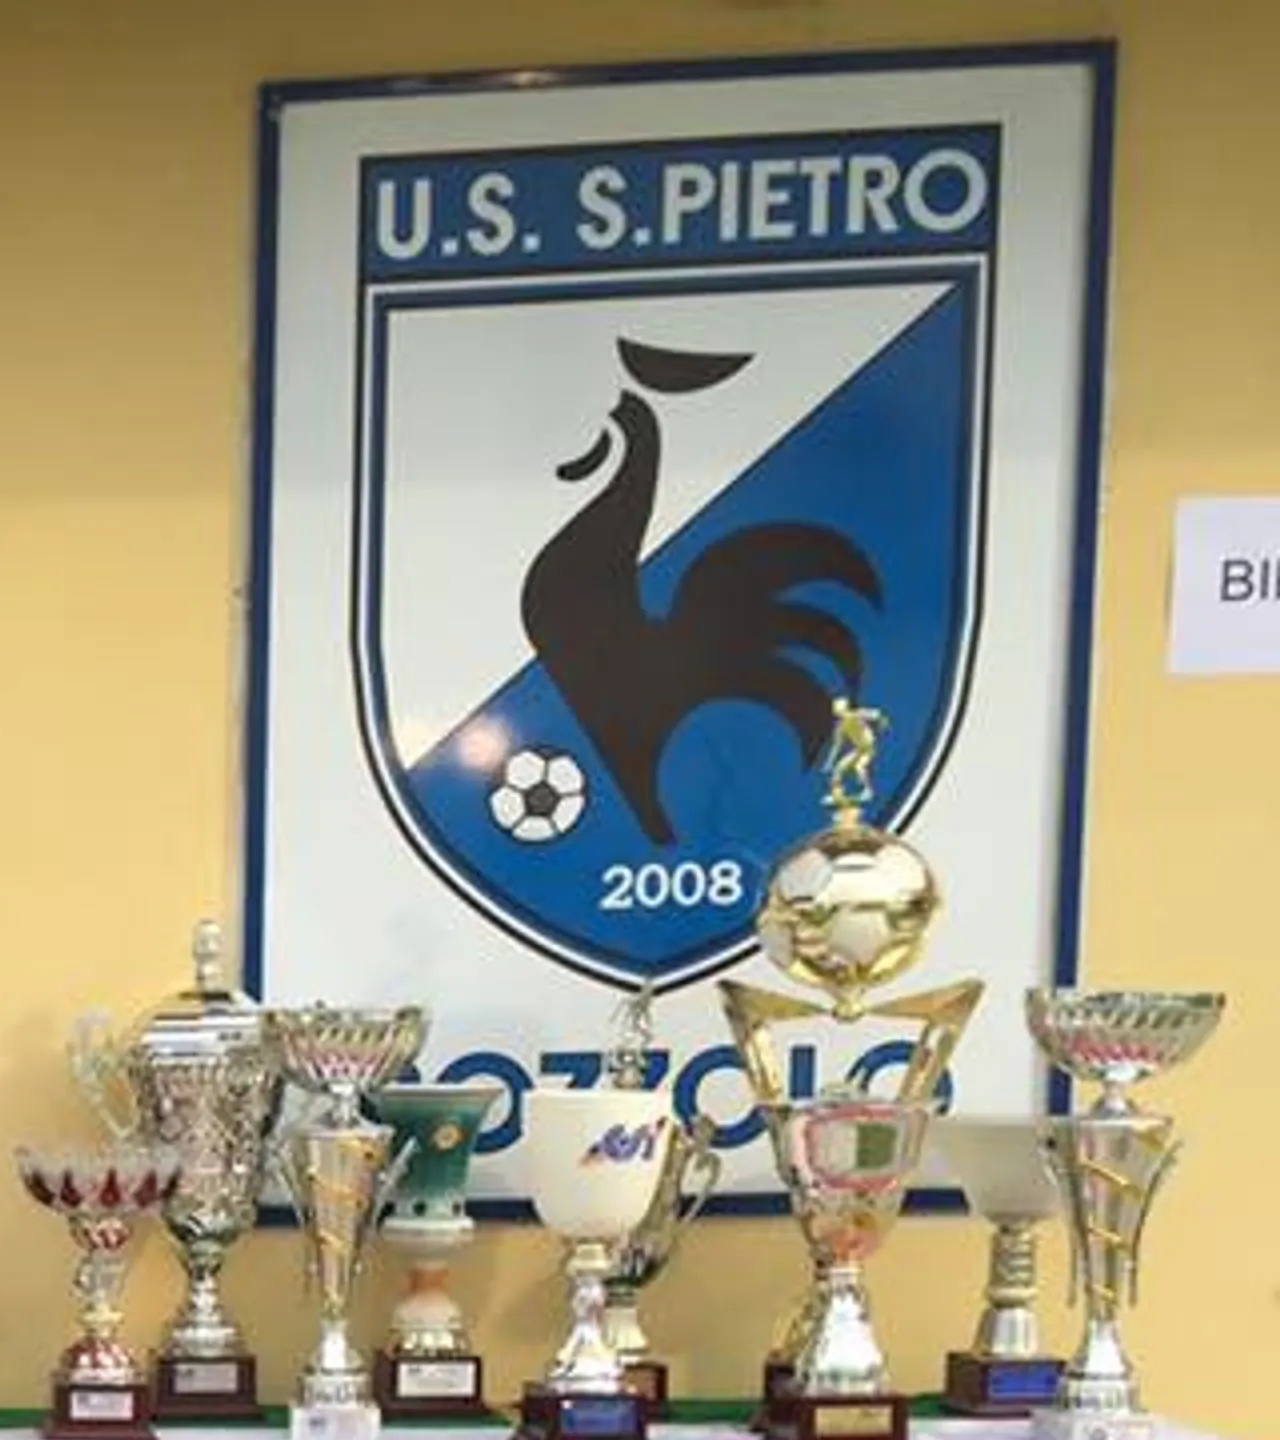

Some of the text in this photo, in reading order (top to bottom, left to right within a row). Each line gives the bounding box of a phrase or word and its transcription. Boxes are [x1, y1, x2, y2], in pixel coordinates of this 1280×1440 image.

[377, 149, 989, 259] U.S. S.PIETRO
[1220, 557, 1280, 602] BI
[599, 860, 743, 910] 2008
